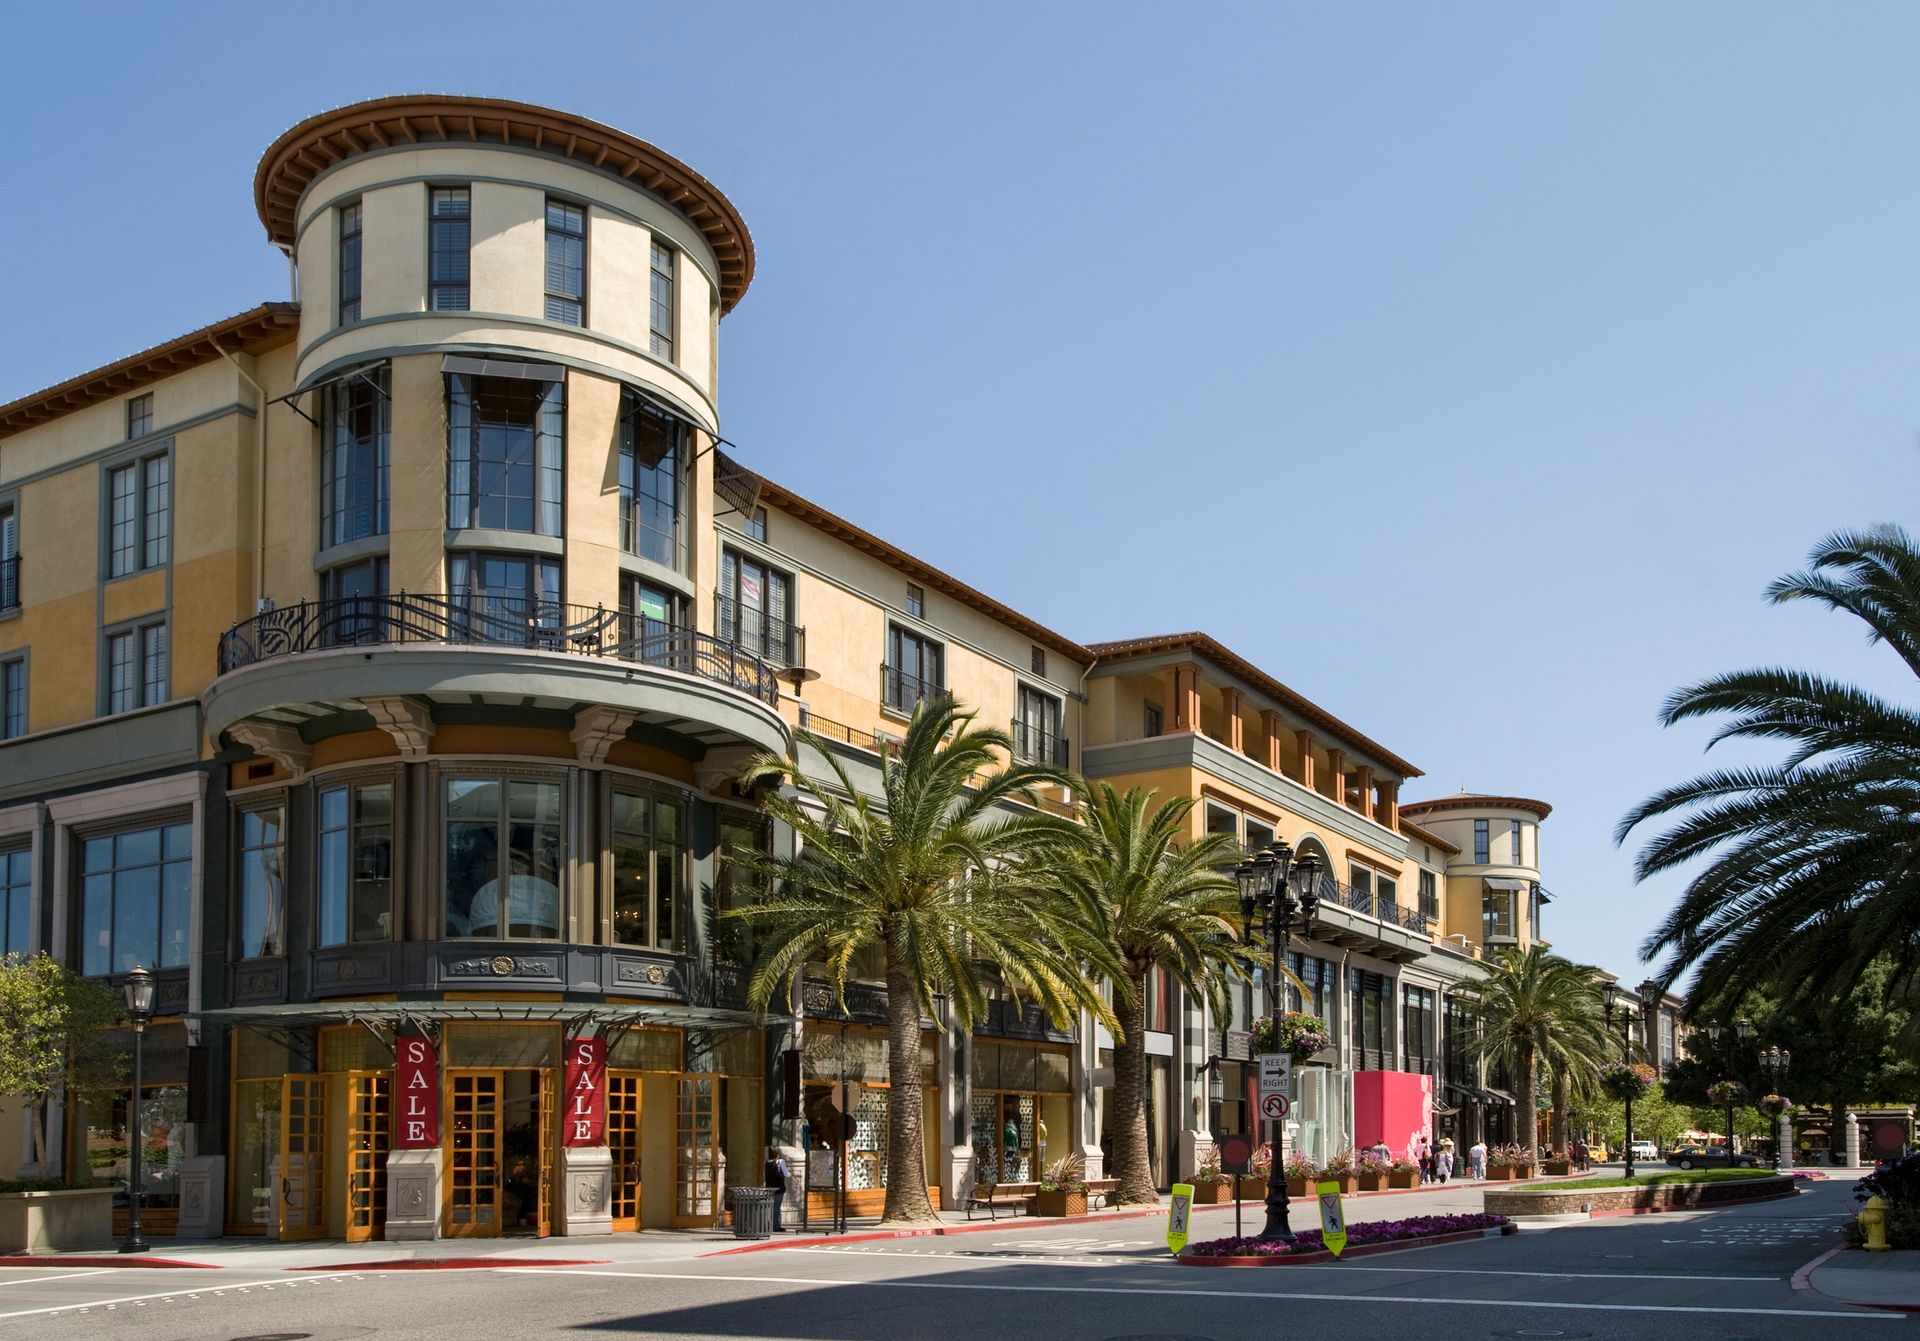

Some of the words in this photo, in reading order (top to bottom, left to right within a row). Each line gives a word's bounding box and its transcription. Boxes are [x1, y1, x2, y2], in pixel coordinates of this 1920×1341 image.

[1263, 1079, 1288, 1087] RIGHT
[1264, 1058, 1287, 1066] KEEP
[407, 1042, 428, 1141] SALE
[573, 1044, 595, 1140] SALE
